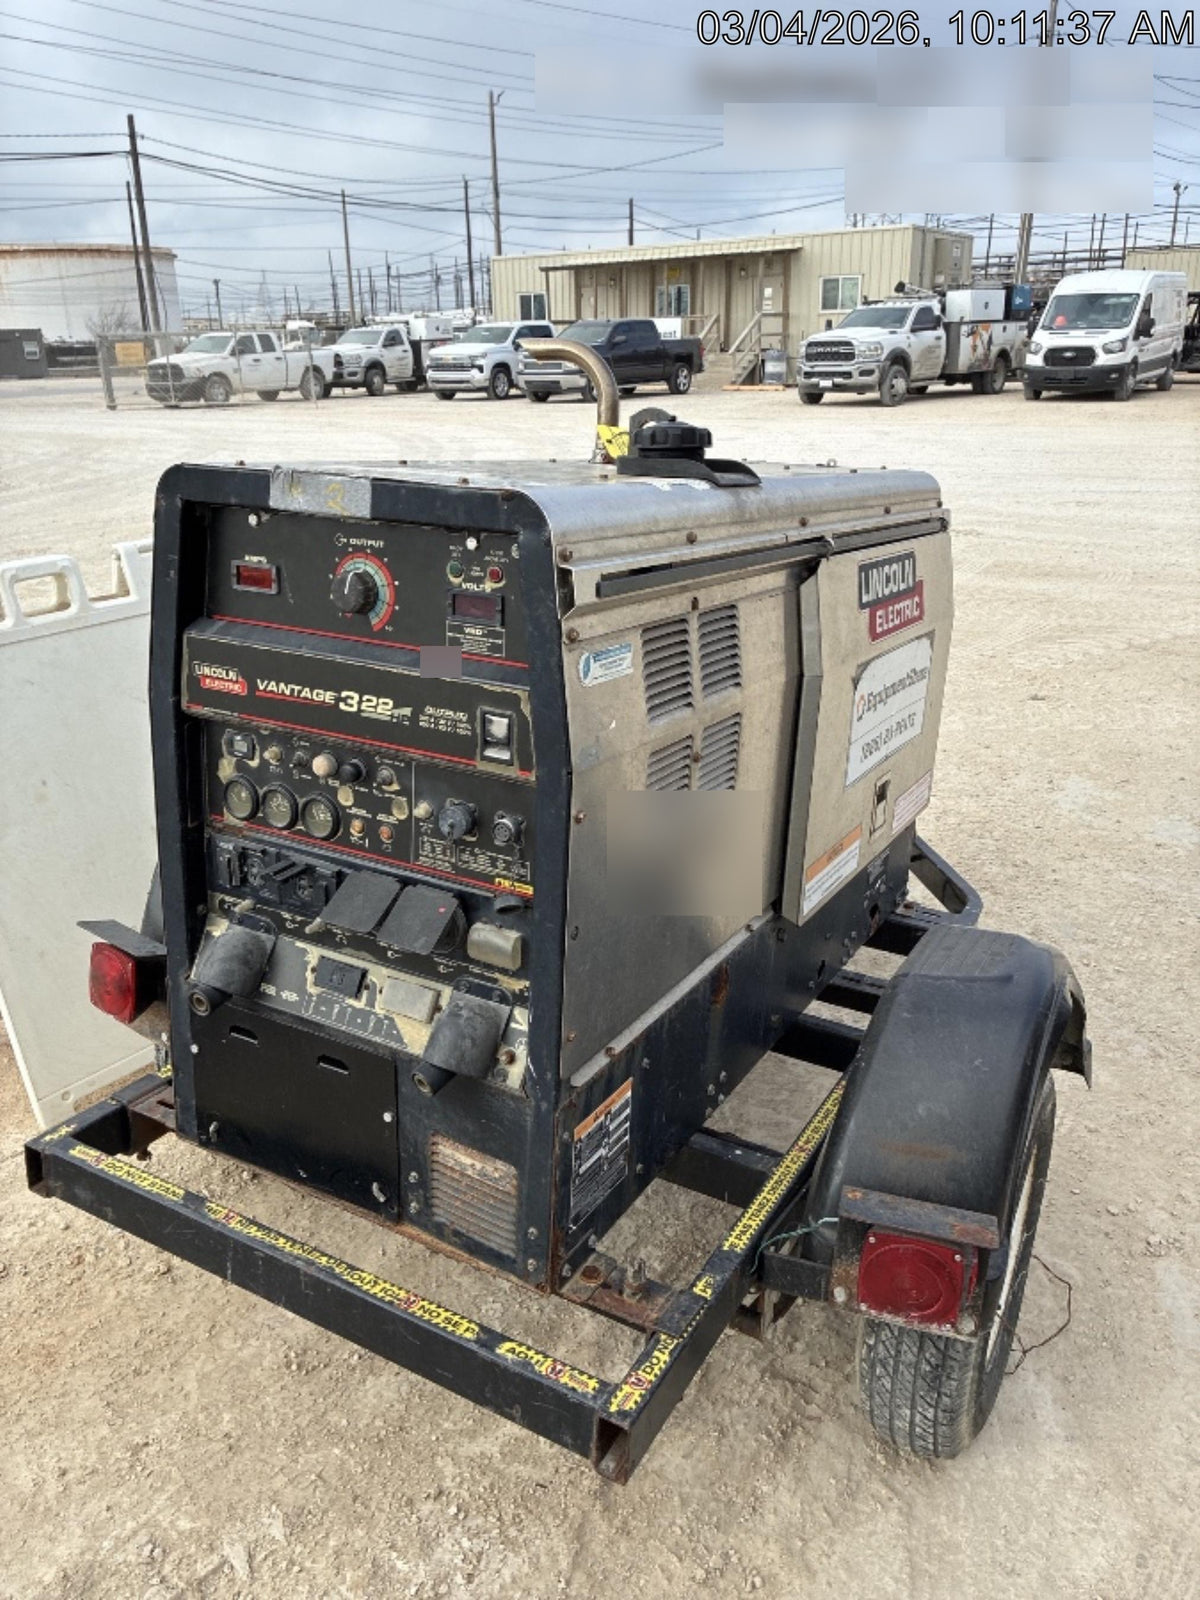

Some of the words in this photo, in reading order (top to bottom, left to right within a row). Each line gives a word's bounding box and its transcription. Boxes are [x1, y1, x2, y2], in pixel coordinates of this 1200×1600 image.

[349, 537, 385, 548] OUTPUT
[861, 557, 914, 604] LINCOLN
[875, 596, 920, 634] ELECTRIC
[194, 664, 239, 682] LINCOLN
[204, 677, 243, 694] ELECTRIC
[256, 678, 336, 703] VANTAGE
[338, 690, 394, 716] 322
[103, 1160, 123, 1174] DO
[122, 1167, 148, 1185] NOT
[733, 1220, 753, 1242] PAS
[416, 1302, 441, 1320] NO
[441, 1314, 463, 1331] SE
[640, 1353, 662, 1377] DO
